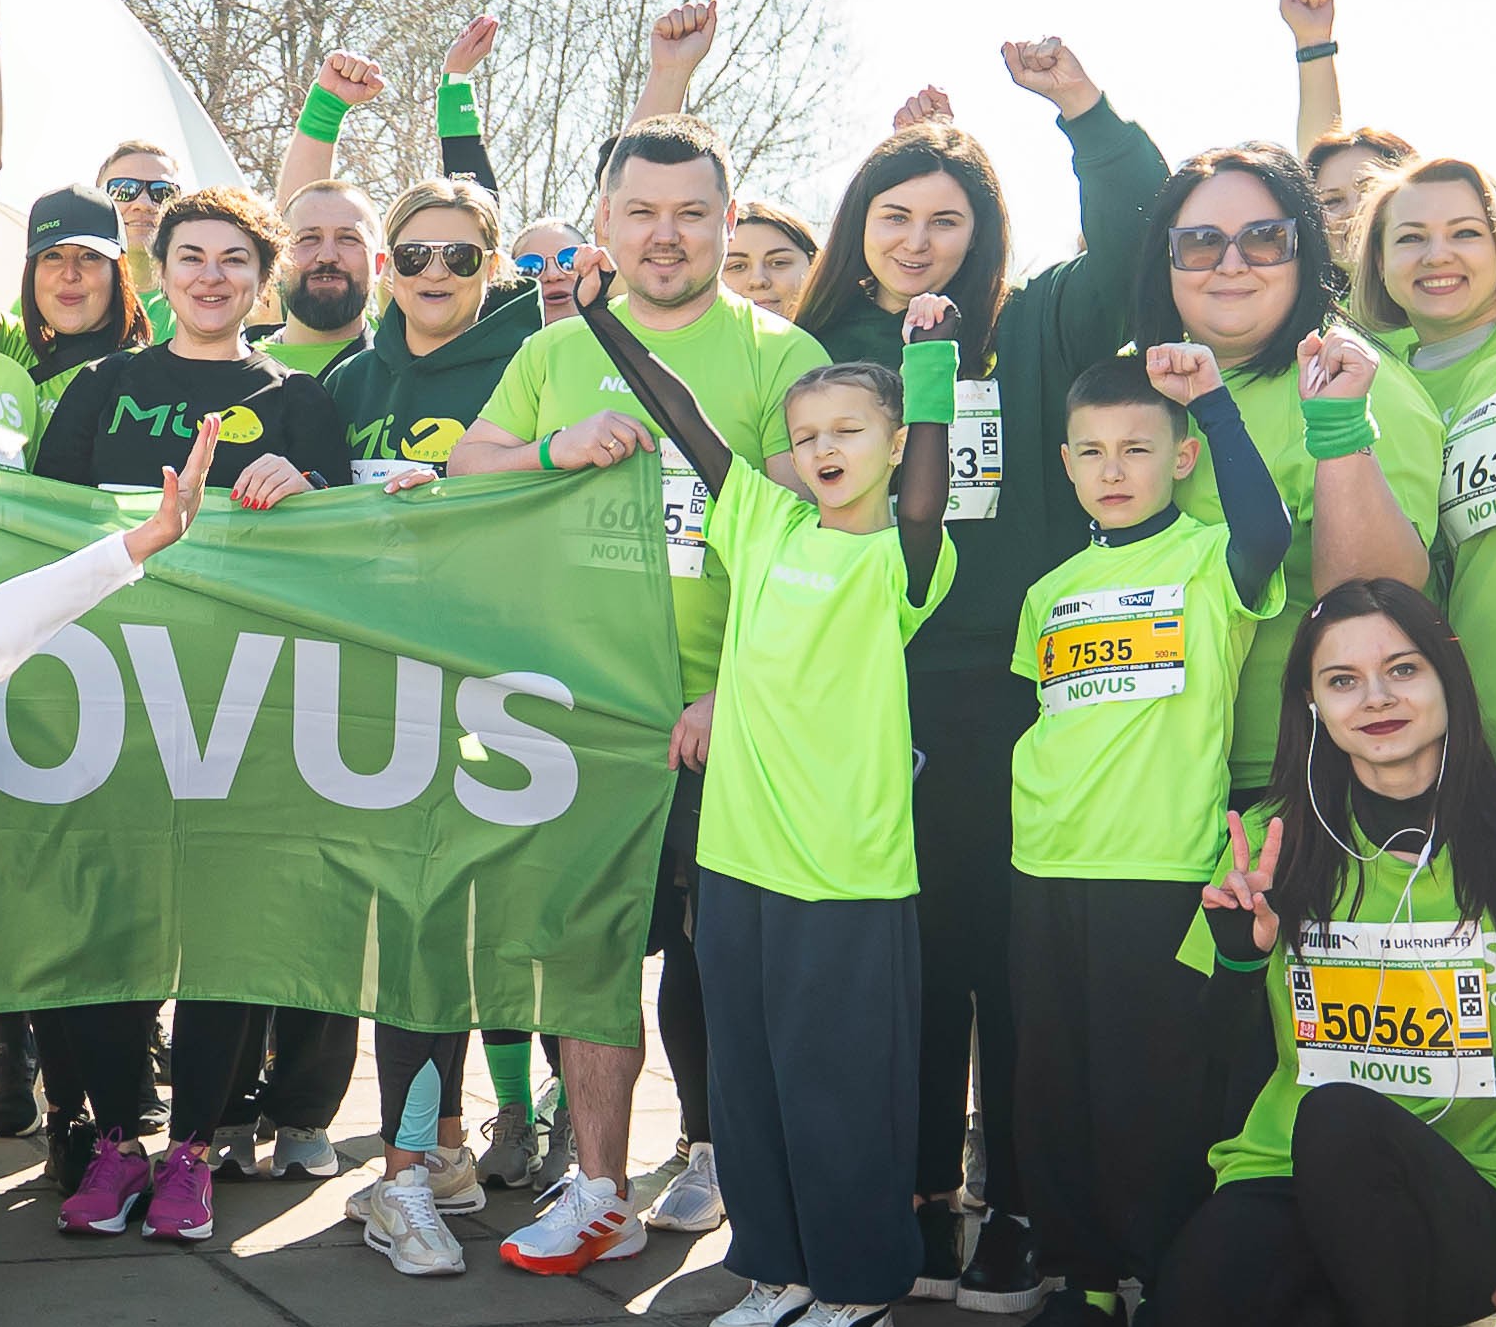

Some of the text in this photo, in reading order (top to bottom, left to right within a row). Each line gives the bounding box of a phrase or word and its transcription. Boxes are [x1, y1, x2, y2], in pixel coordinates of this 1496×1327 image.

[1052, 601, 1080, 619] PUMA
[1069, 638, 1133, 667] 7535
[1067, 677, 1136, 701] NOVUS
[1394, 936, 1471, 949] UKRNAFTA
[1320, 1001, 1454, 1047] 50562
[1350, 1059, 1432, 1085] NOVUS
